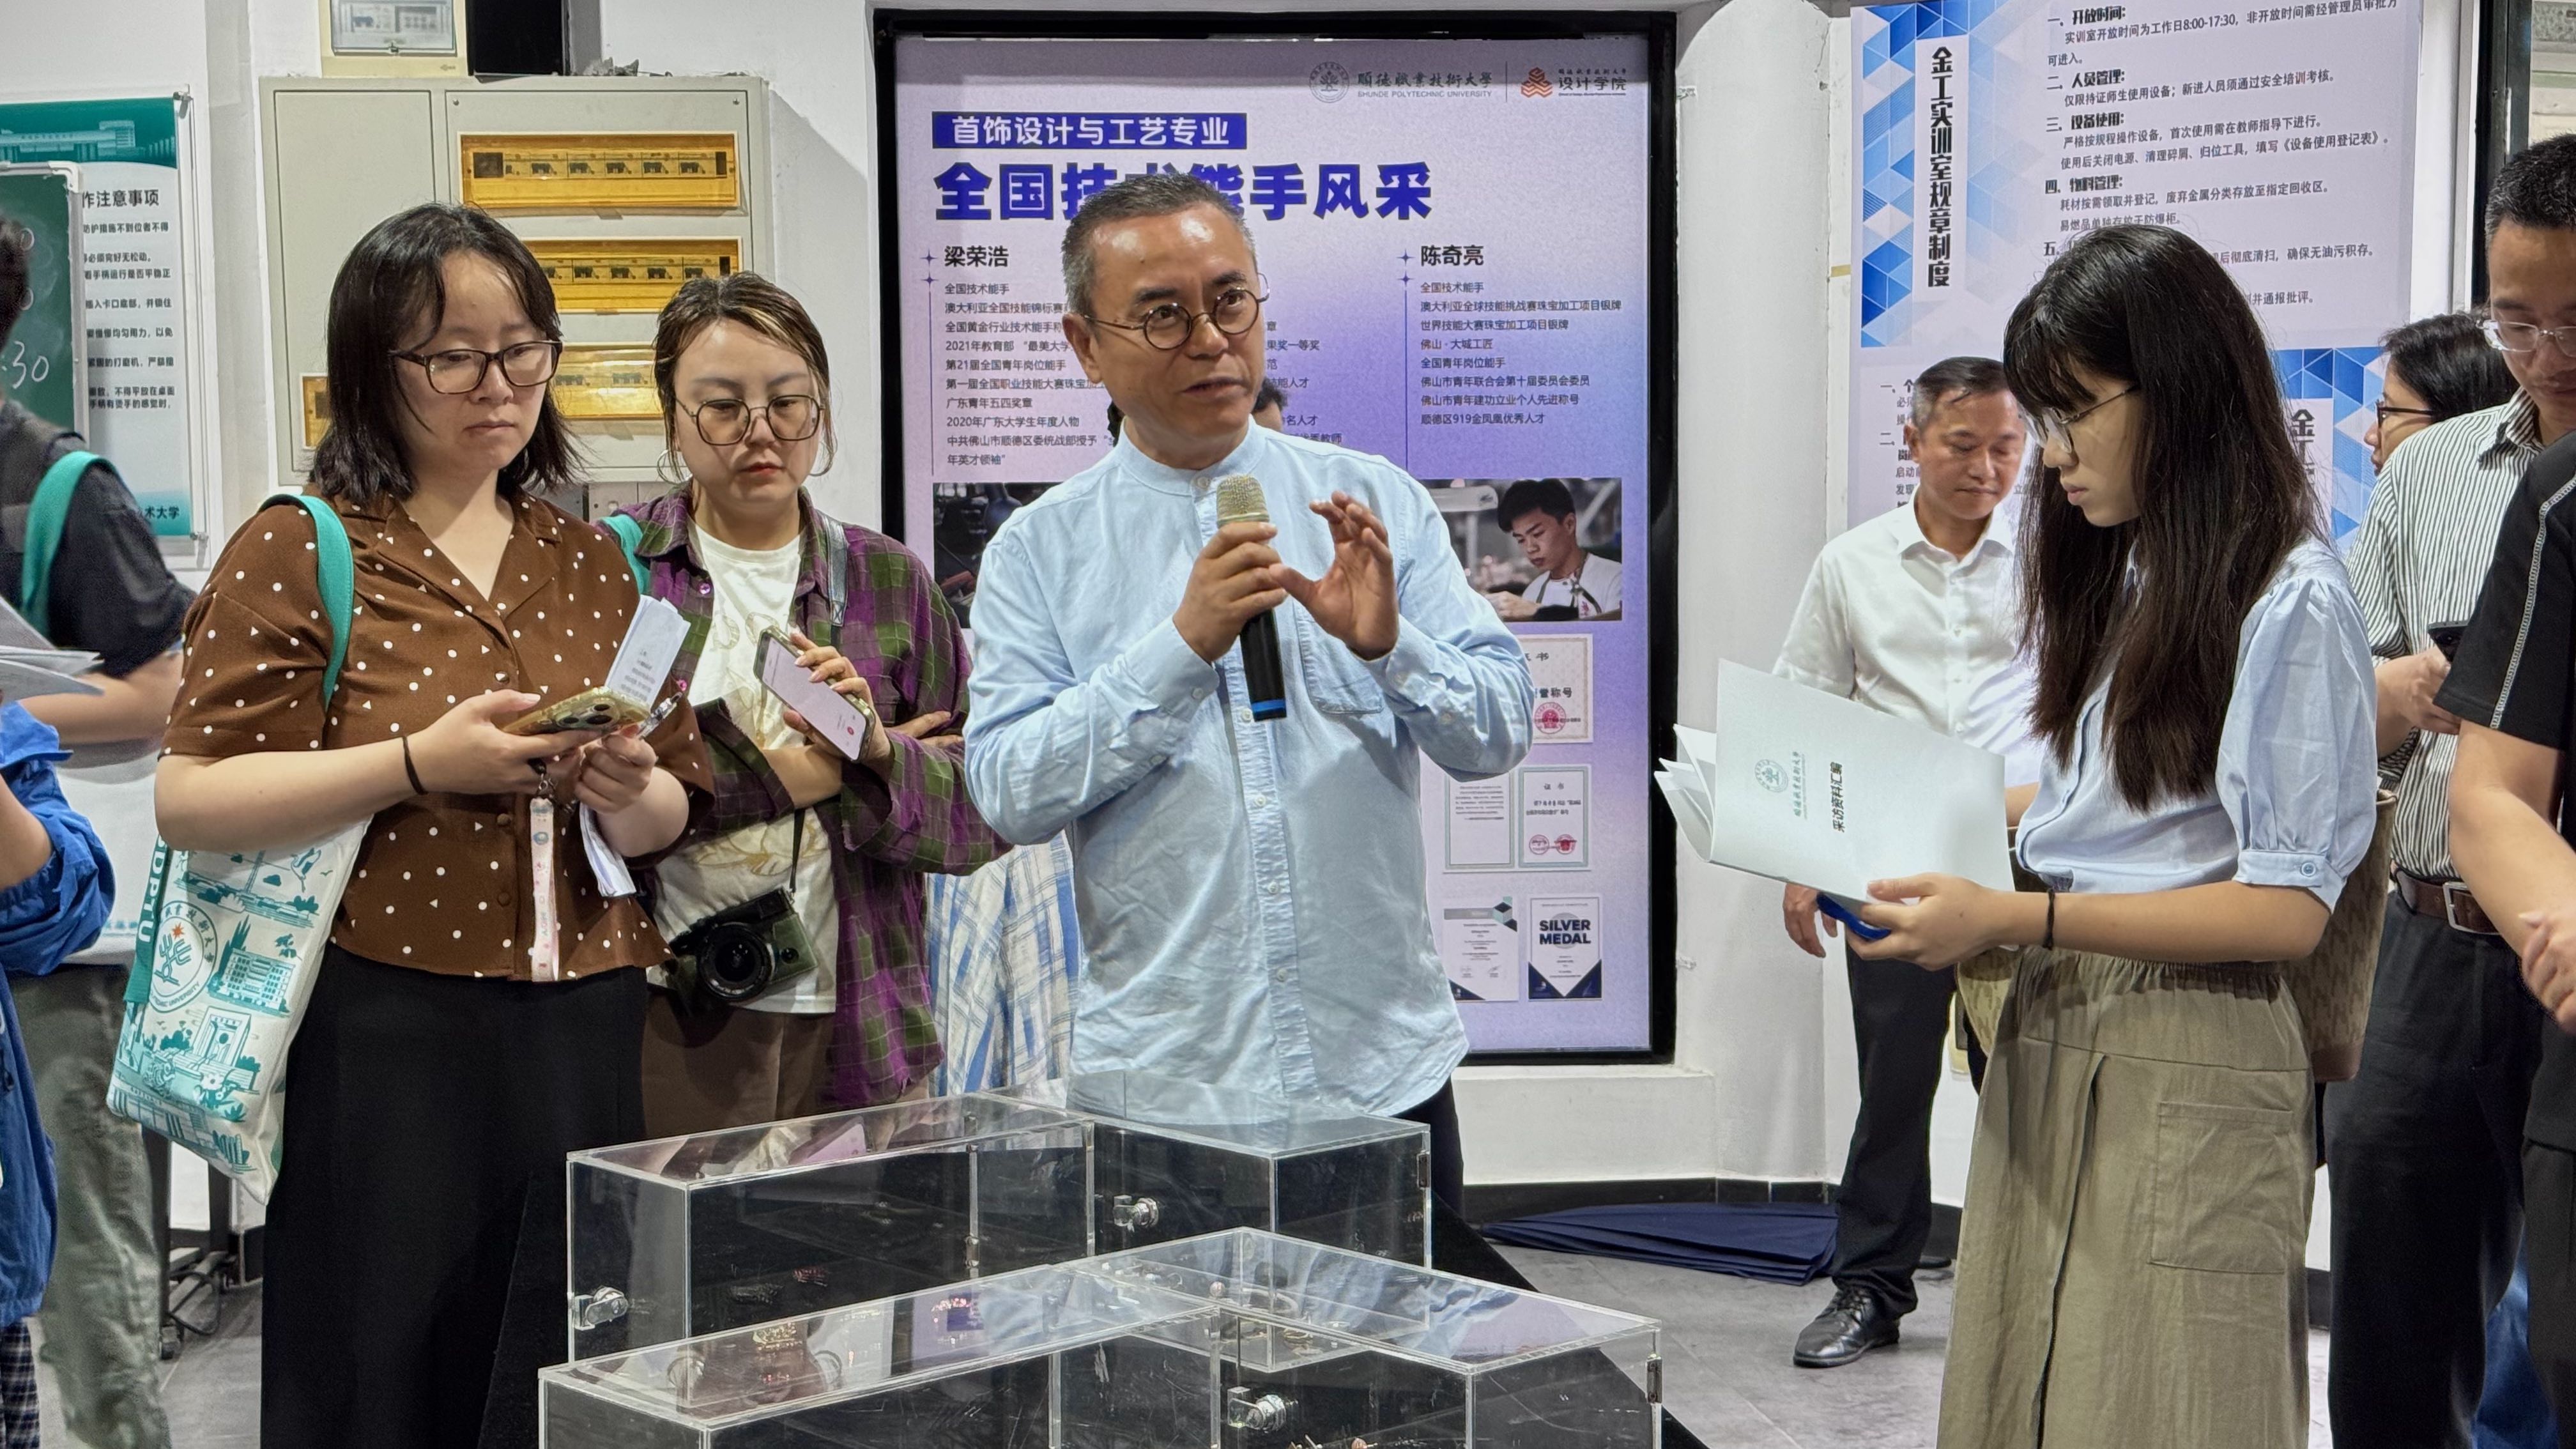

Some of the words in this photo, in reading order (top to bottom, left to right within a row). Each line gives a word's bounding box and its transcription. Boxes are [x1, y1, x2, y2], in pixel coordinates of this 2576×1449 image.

[2048, 52, 2083, 66] 可进入。
[1558, 77, 1627, 90] 设计学院
[952, 116, 1230, 146] 首饰设计与工艺专业
[1928, 47, 1953, 287] 金工实训室规章制度
[933, 161, 1432, 220] 全国技能手风采
[82, 189, 159, 208] 作注意事项
[944, 245, 1009, 267] 梁荣浩
[1421, 245, 1484, 266] 陈奇亮
[945, 283, 1010, 295] 全国技术能手
[1420, 282, 1484, 293] 全国技术能手
[1420, 300, 1621, 312] 澳大利亚全球技能挑战赛珠宝加工项目银牌
[1420, 319, 1569, 331] 世界技能大赛珠宝加工项目银牌
[946, 340, 1074, 352] 2021年教育部“最美大学
[946, 359, 1066, 371] 第21届全国青年岗位能手
[1420, 357, 1506, 369] 全国青年岗位能手
[1420, 375, 1590, 387] 佛山市青年联合会第十届委员会委员
[946, 397, 1033, 409] 广东青年五四奖章
[1420, 394, 1579, 406] 佛山市青年建功立业个人先进称号
[947, 416, 1080, 427] 2020年广东大学生年度人物
[1282, 415, 1318, 426] 名人才
[1420, 413, 1545, 424] 顺德区919金凤凰优秀人才
[1830, 762, 1845, 833] 采访资料汇编
[1539, 919, 1591, 932] SILVER
[1539, 933, 1591, 945] MEDAL
